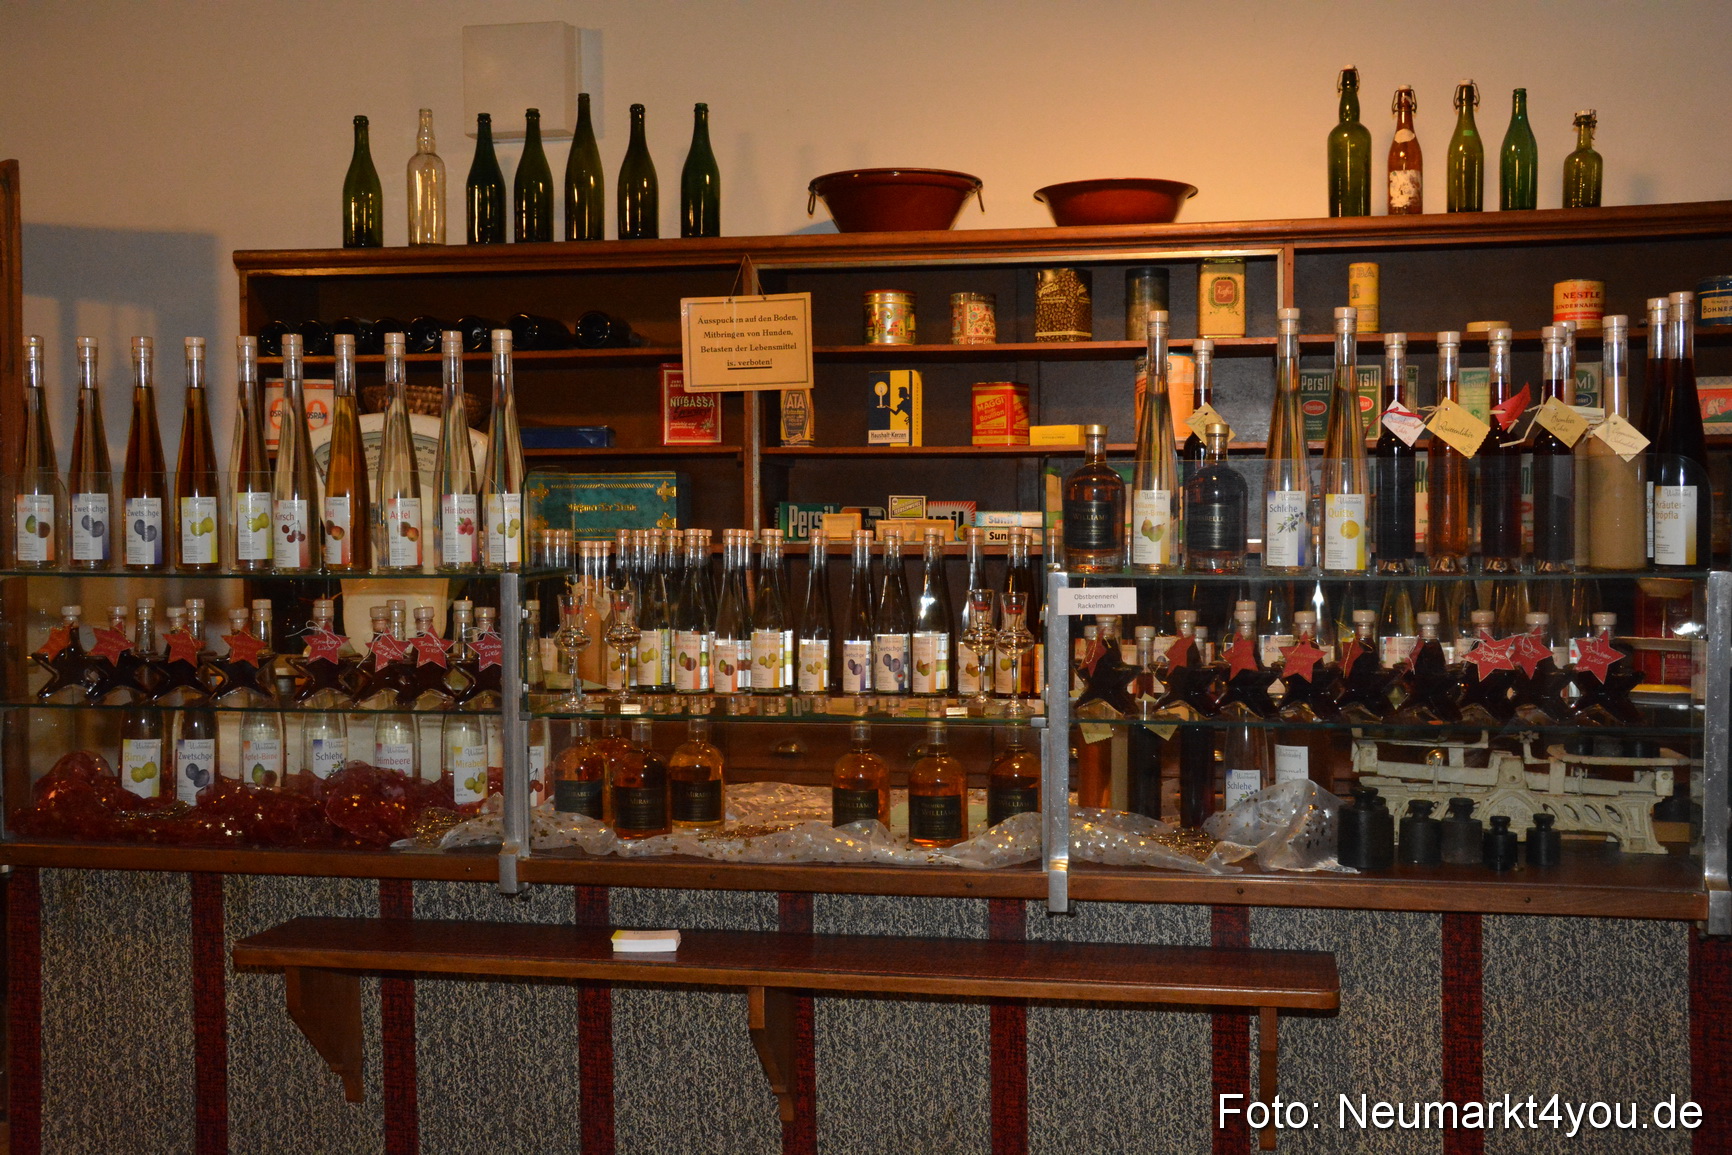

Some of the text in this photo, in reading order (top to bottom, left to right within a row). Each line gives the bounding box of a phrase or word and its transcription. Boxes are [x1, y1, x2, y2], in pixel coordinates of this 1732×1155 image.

[698, 316, 743, 325] Ausspucken
[744, 314, 757, 323] auf
[703, 330, 745, 339] Mitbringen
[700, 343, 797, 353] Betasten der Lebensmittel
[737, 358, 773, 367] verboten!
[1301, 375, 1330, 391] Persil
[786, 393, 806, 409] ATA
[976, 396, 1005, 412] MAGGI
[306, 411, 327, 420] OSRAM
[788, 505, 834, 537] Pers
[988, 531, 1008, 541] Sun
[124, 751, 147, 762] Birne
[178, 751, 213, 762] Zwetschge
[315, 751, 343, 761] Schlehe
[1227, 780, 1252, 790] Schlehe
